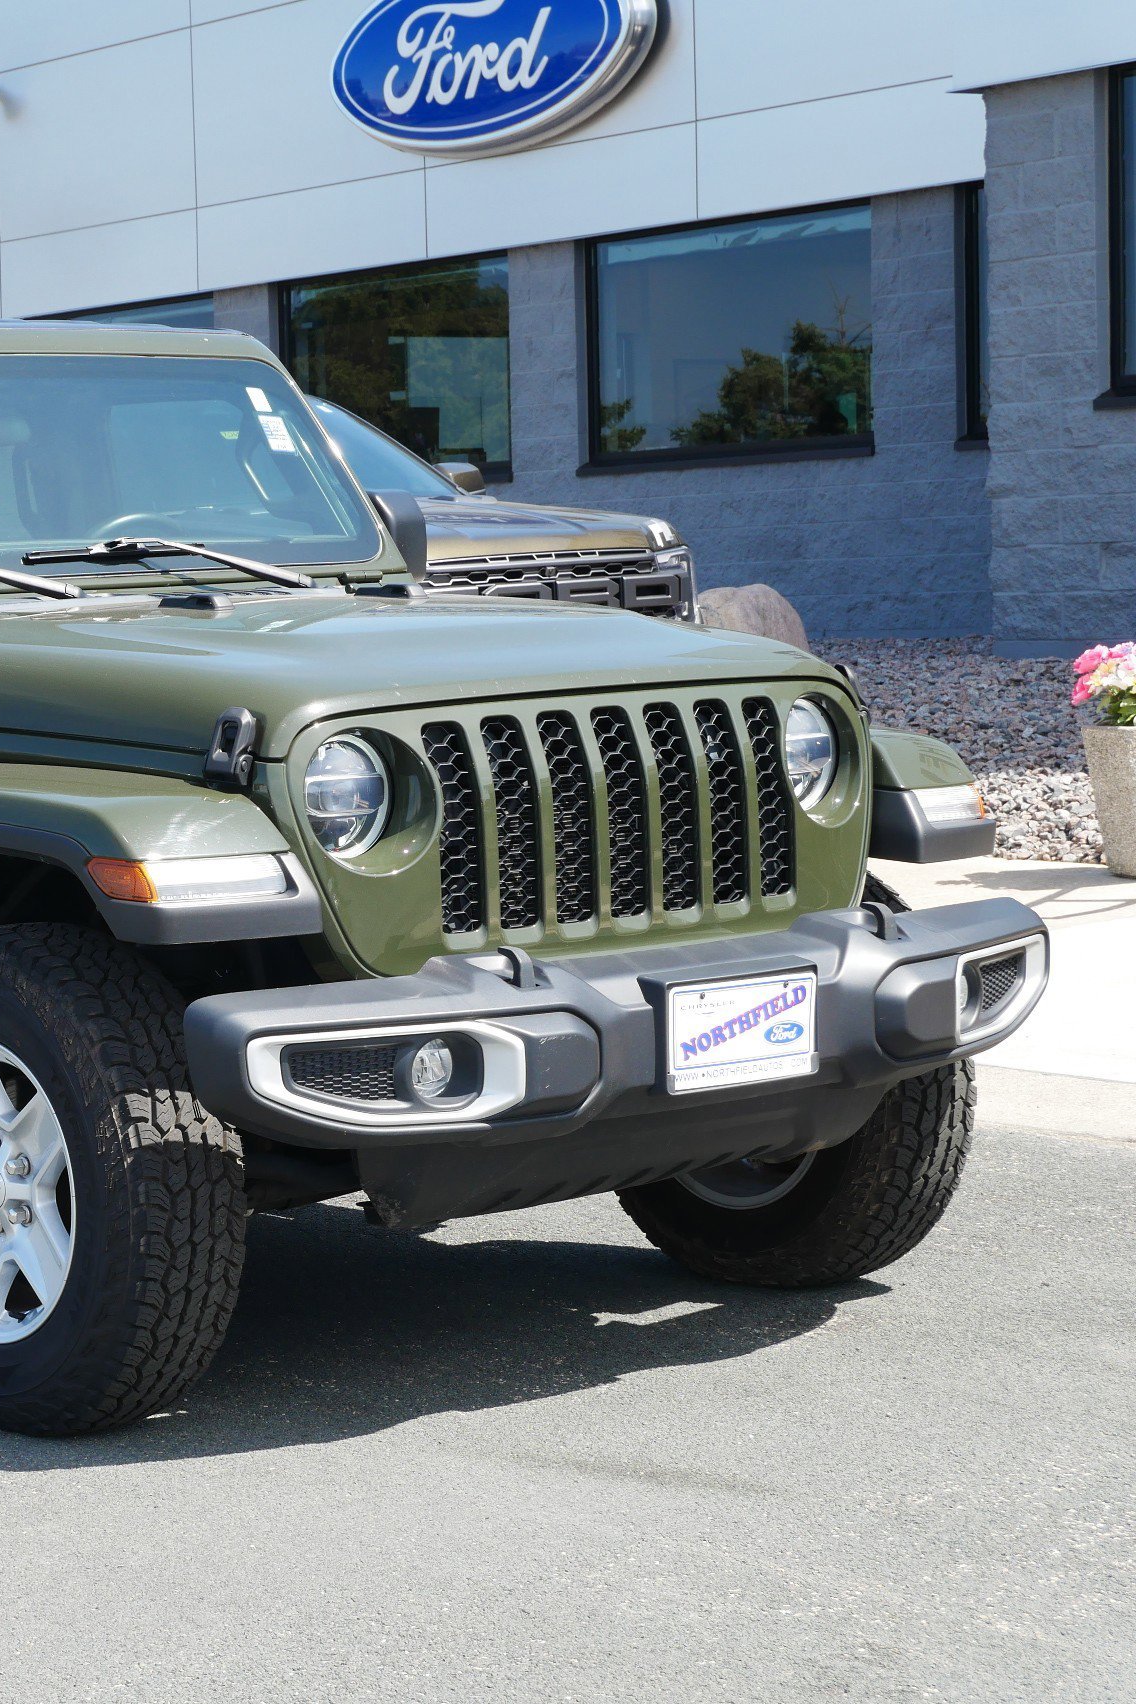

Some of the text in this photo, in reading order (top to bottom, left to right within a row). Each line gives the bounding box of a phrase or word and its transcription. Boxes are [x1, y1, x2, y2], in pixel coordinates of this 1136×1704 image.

[383, 0, 551, 115] Ford
[680, 985, 807, 1061] NORTHFIELD
[770, 1022, 798, 1042] Ford
